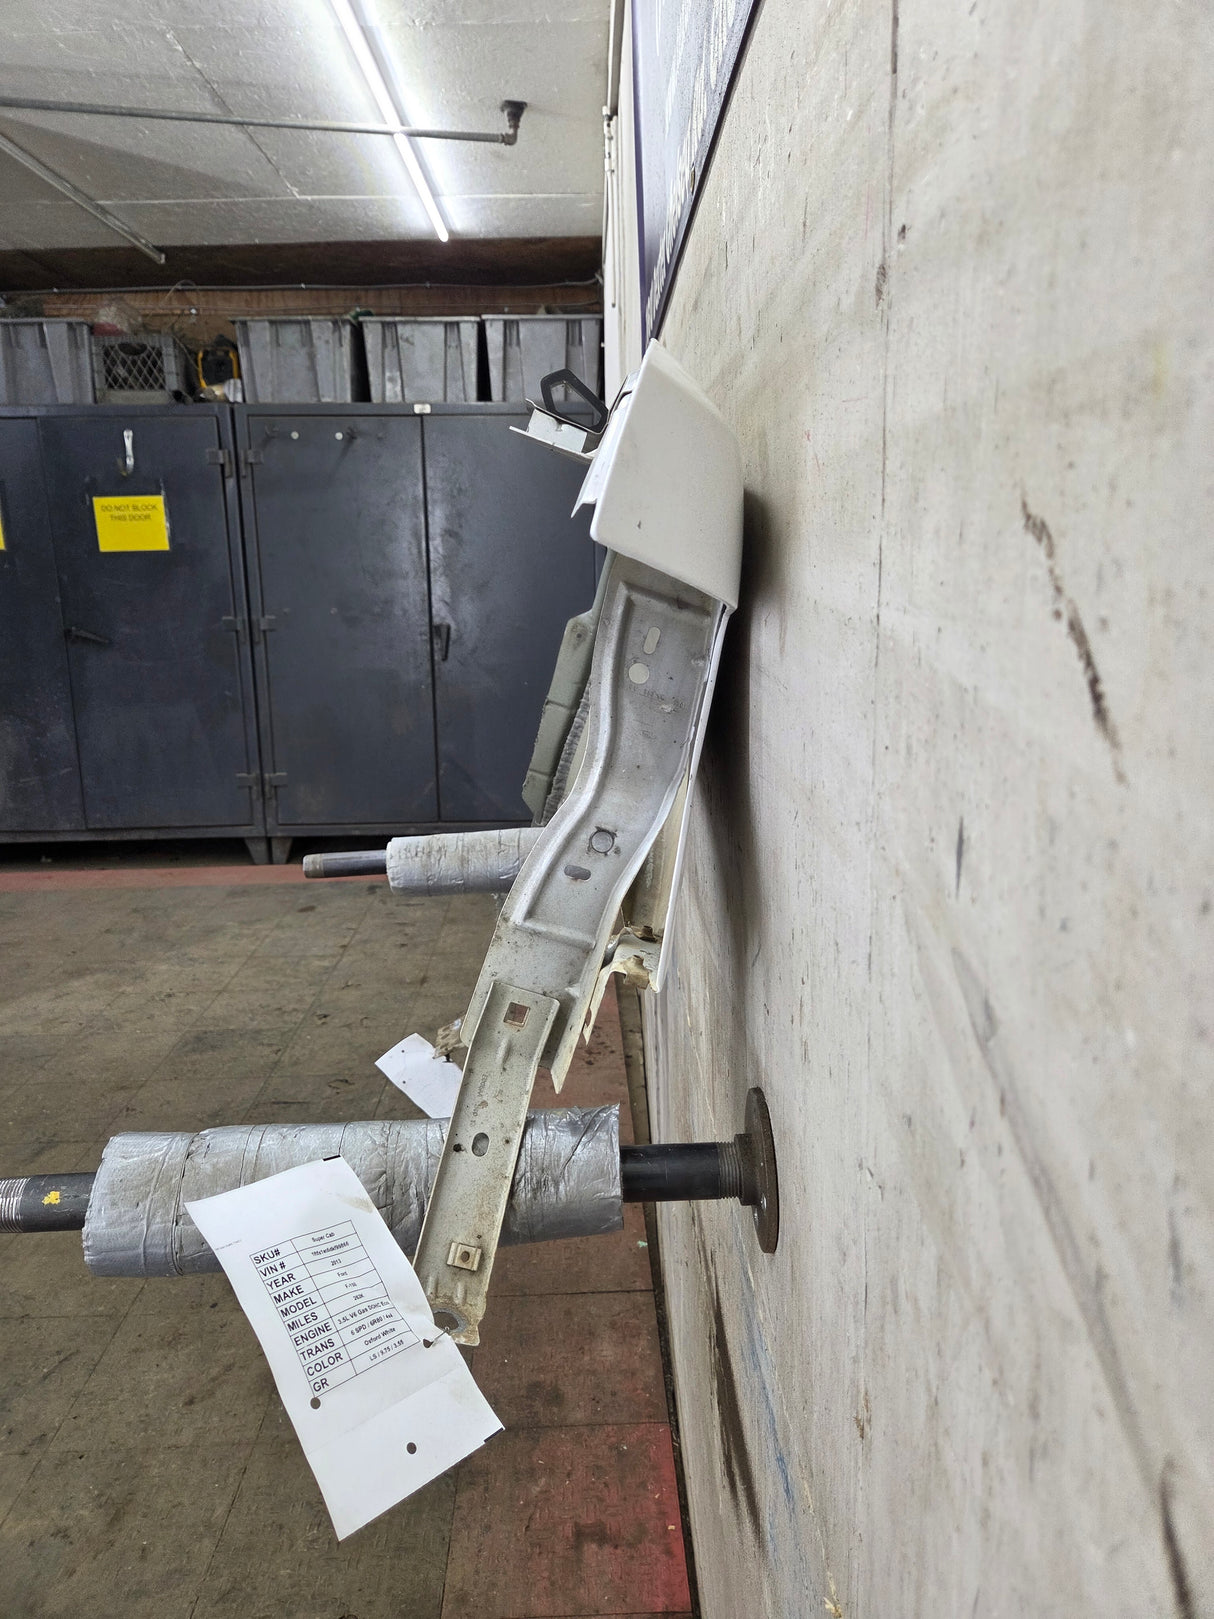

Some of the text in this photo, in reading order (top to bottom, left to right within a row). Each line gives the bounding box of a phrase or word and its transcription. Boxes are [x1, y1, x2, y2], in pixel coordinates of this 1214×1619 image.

[114, 504, 130, 512] NOT
[131, 504, 158, 512] BLOCK
[254, 1248, 280, 1264] SKU#
[330, 1258, 342, 1266] 2013
[260, 1261, 286, 1277] VIN #
[266, 1272, 296, 1290] YEAR
[273, 1284, 304, 1304] MAKE
[280, 1296, 317, 1318] MODEL
[337, 1316, 349, 1325] 3.5L
[357, 1307, 368, 1315] Gas
[287, 1312, 318, 1332] MILES
[355, 1324, 367, 1334] SPD
[294, 1322, 332, 1346] ENGINE
[364, 1328, 396, 1346] Oxford White
[300, 1338, 335, 1360] TRANS
[380, 1346, 391, 1355] 9.75
[307, 1352, 343, 1376] COLOR
[313, 1378, 329, 1392] GR
